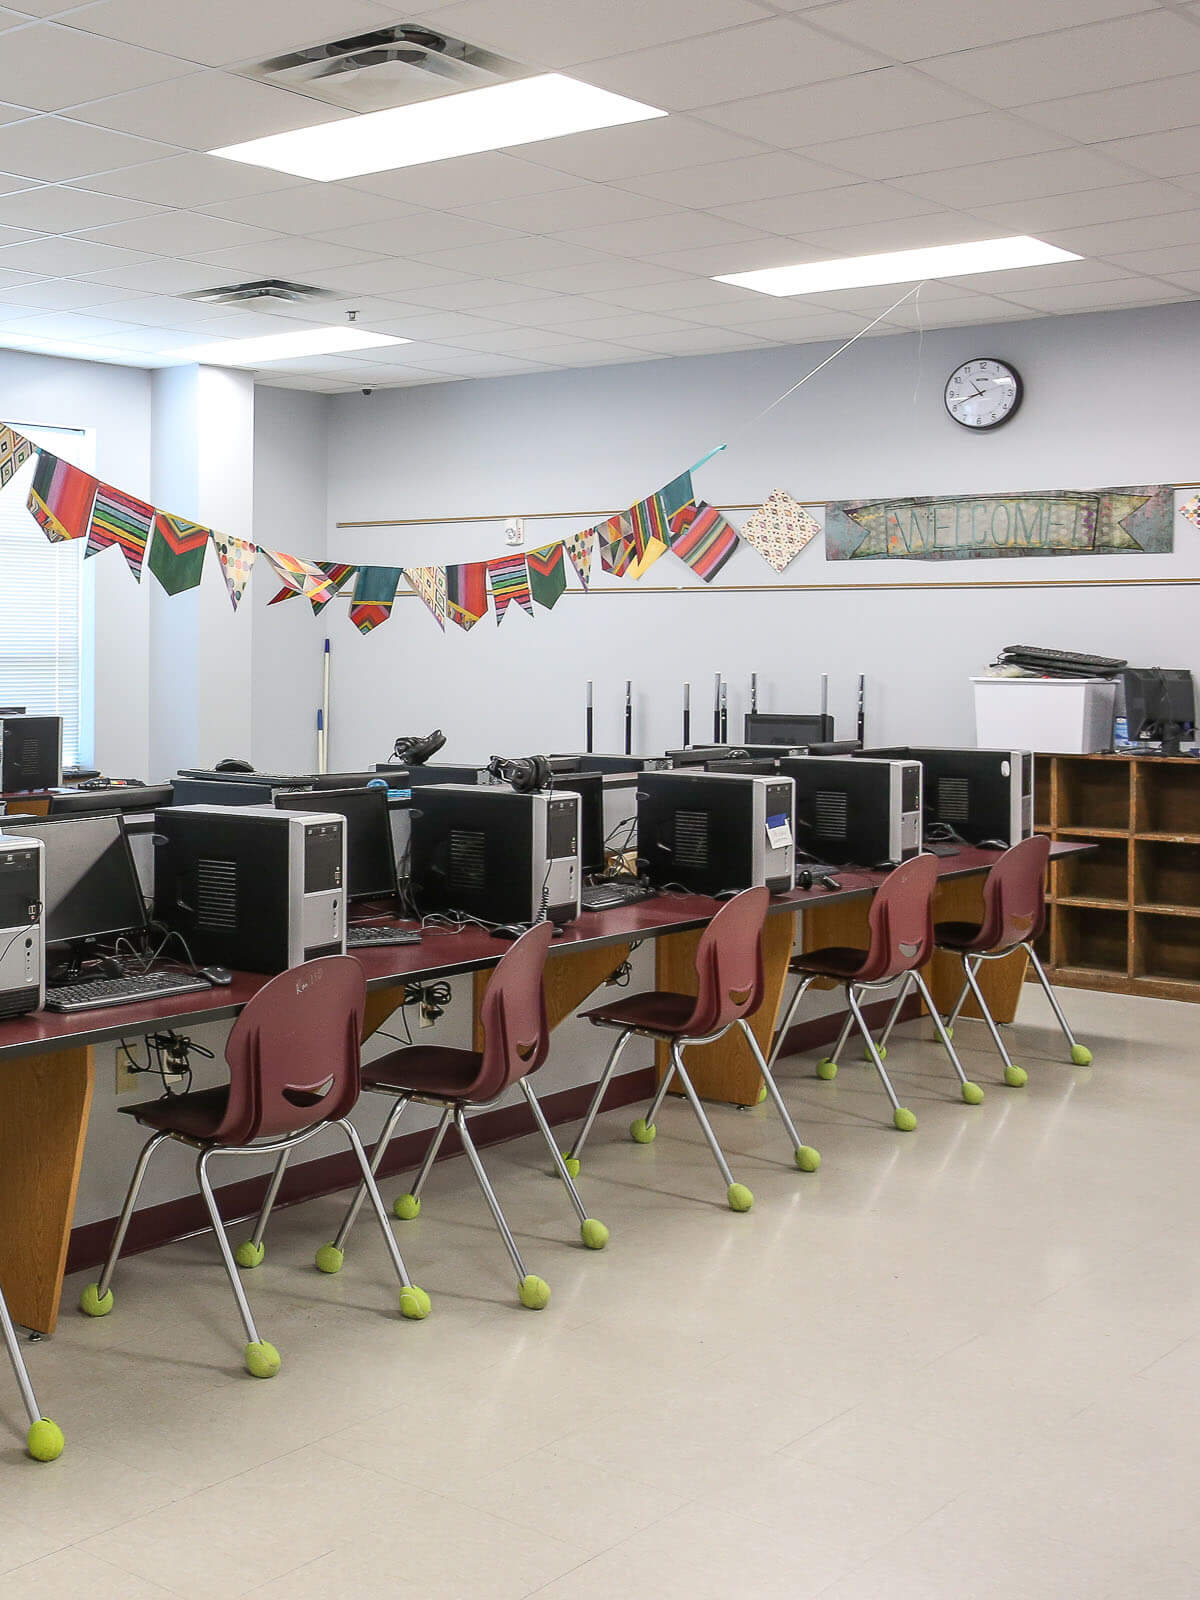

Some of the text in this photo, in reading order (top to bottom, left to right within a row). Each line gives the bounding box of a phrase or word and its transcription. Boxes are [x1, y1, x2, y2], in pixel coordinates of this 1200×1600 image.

[979, 361, 988, 370] 12
[949, 390, 955, 399] 9
[1007, 388, 1013, 397] 3
